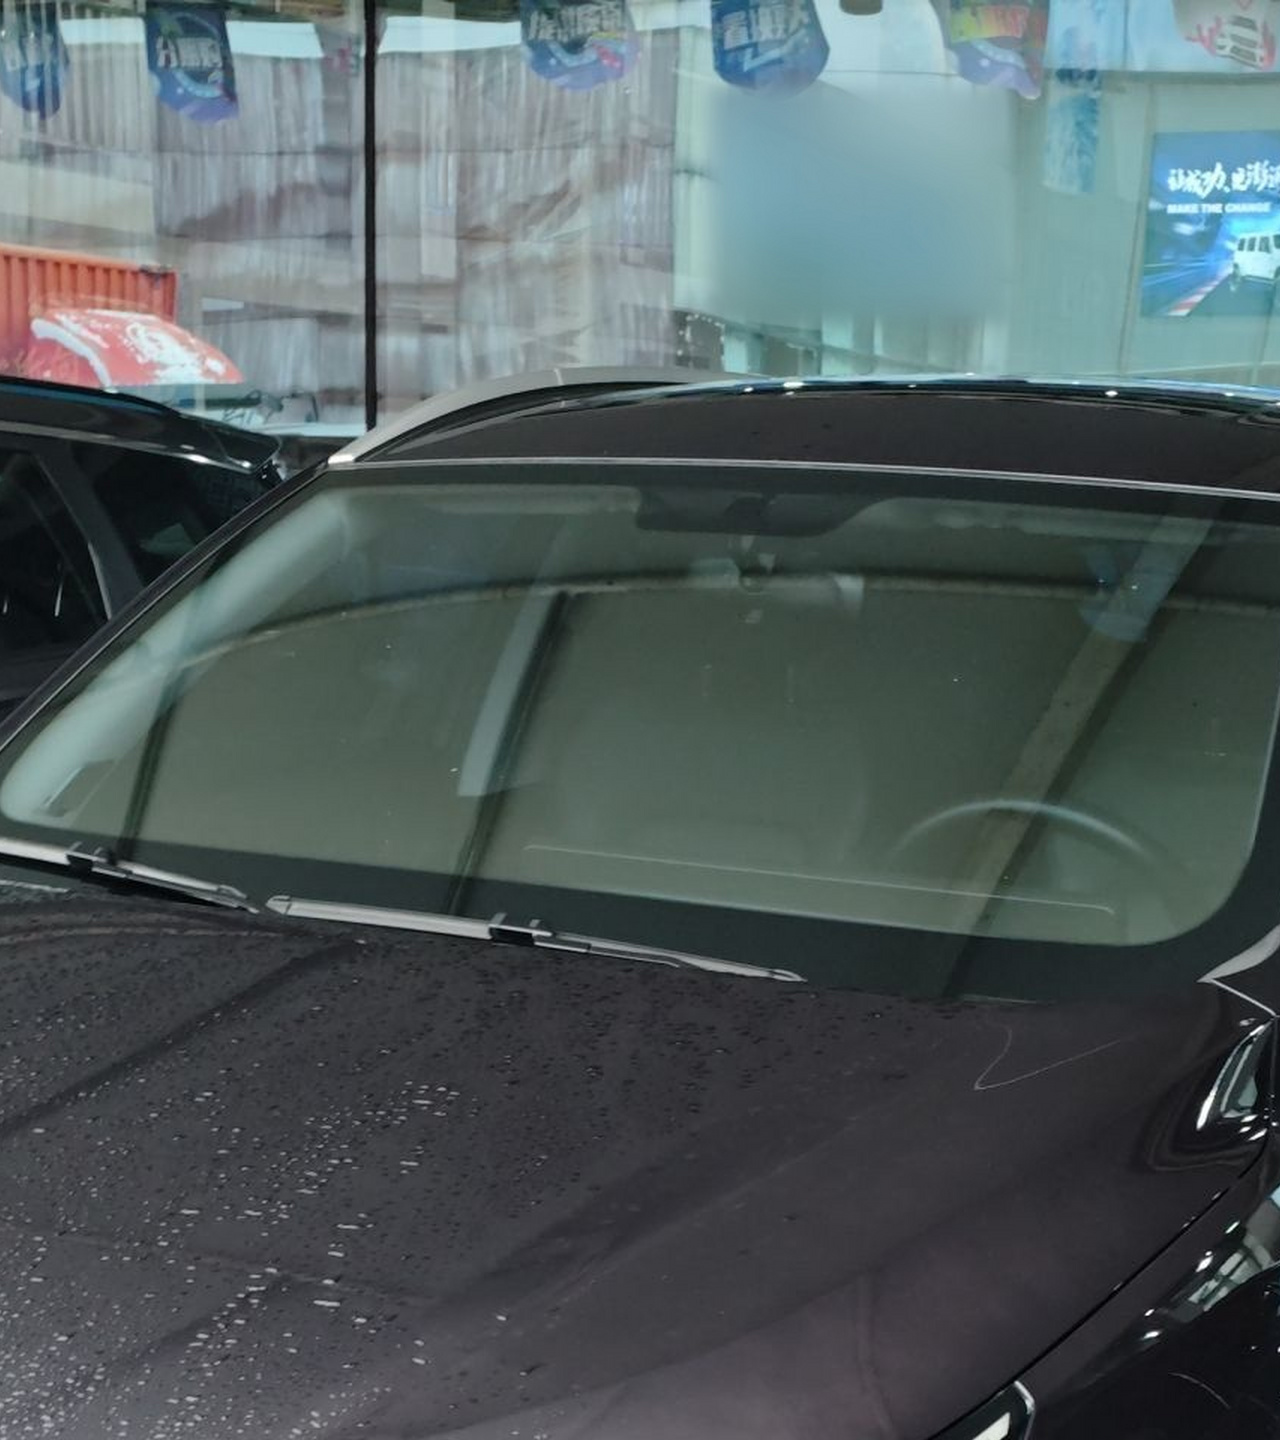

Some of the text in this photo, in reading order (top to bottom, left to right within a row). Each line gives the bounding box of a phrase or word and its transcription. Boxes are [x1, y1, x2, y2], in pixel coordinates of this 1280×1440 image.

[1166, 202, 1272, 213] MAKE THE CHANGE
